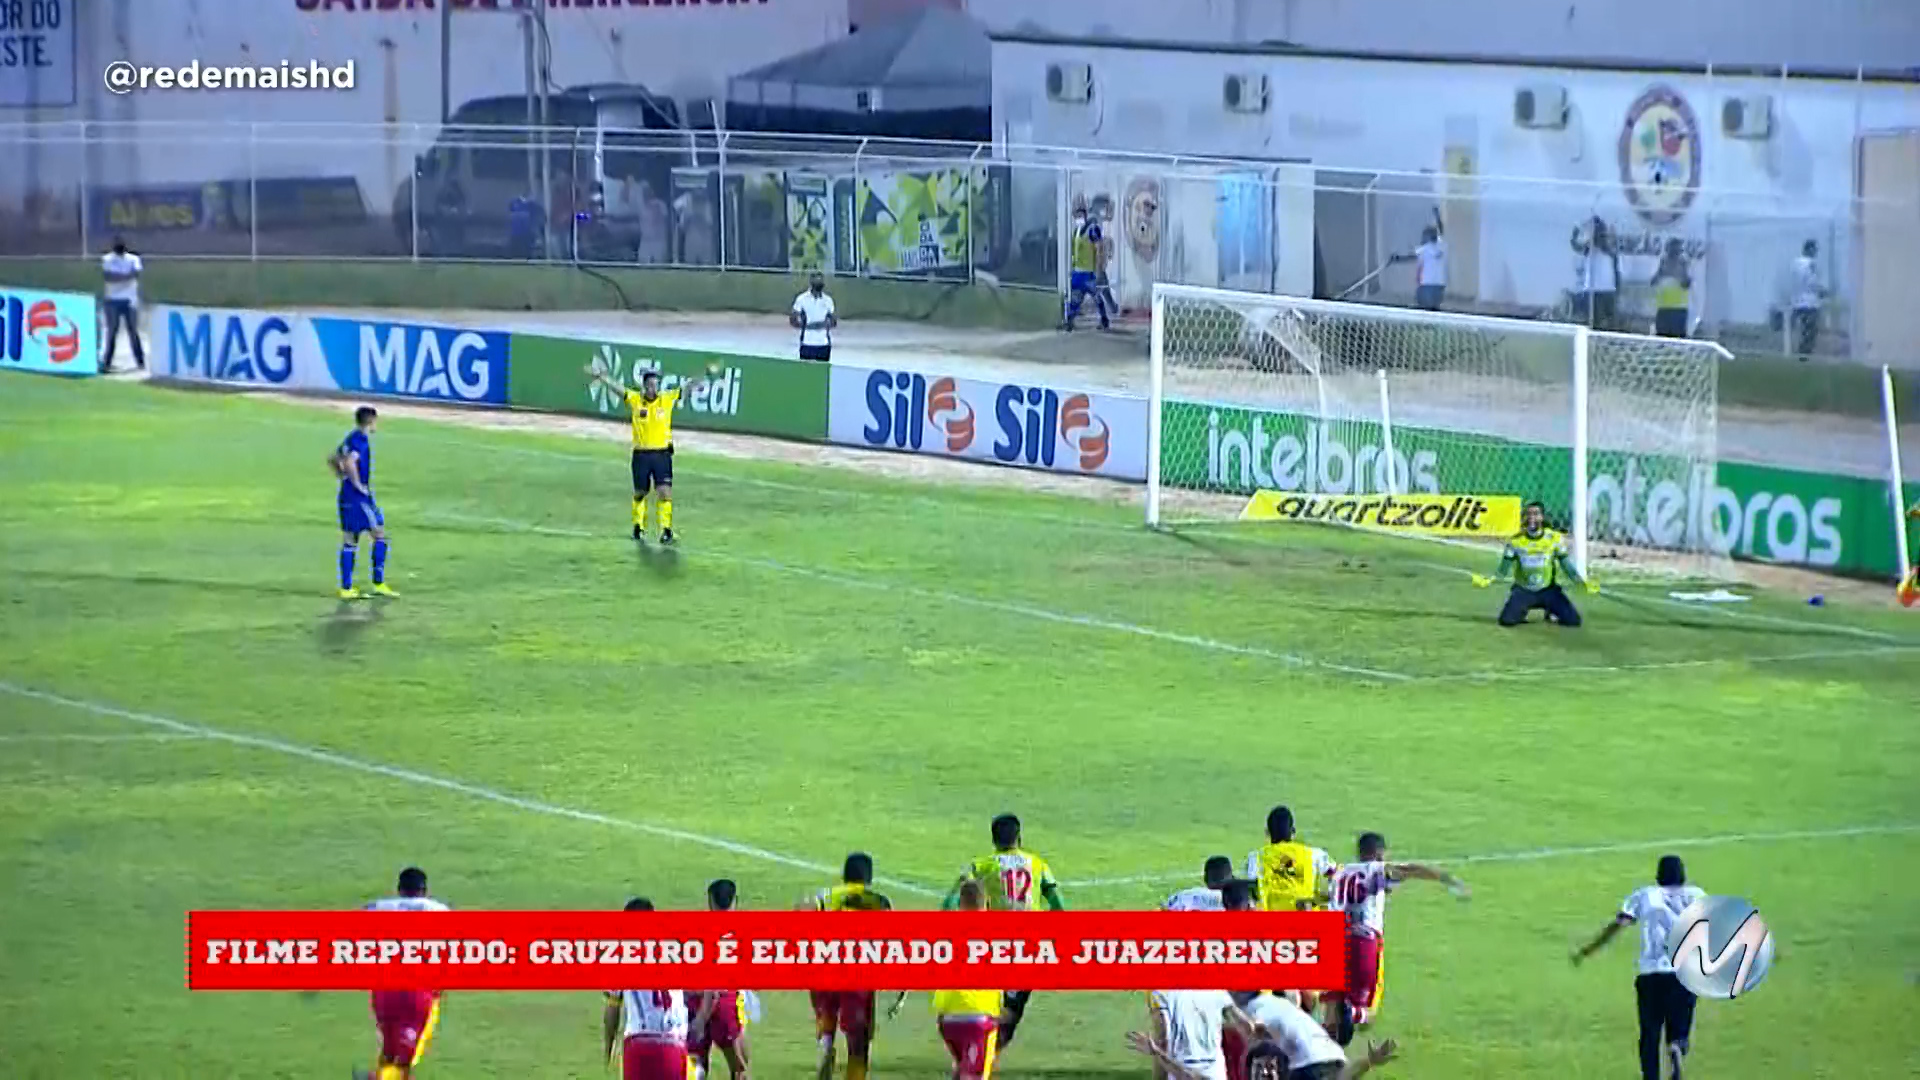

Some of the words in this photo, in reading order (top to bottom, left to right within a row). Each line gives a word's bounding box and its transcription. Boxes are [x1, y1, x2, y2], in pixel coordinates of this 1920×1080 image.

[0, 36, 53, 67] STE.
[168, 311, 293, 383] MAG
[359, 325, 490, 399] MAG
[633, 358, 742, 416] Scredi
[864, 369, 926, 450] Sil
[994, 384, 1059, 467] Sil
[1208, 408, 1439, 495] intelbras
[1277, 496, 1487, 531] quartzolit
[1588, 456, 1842, 565] ntelbras
[1001, 868, 1031, 902] 12
